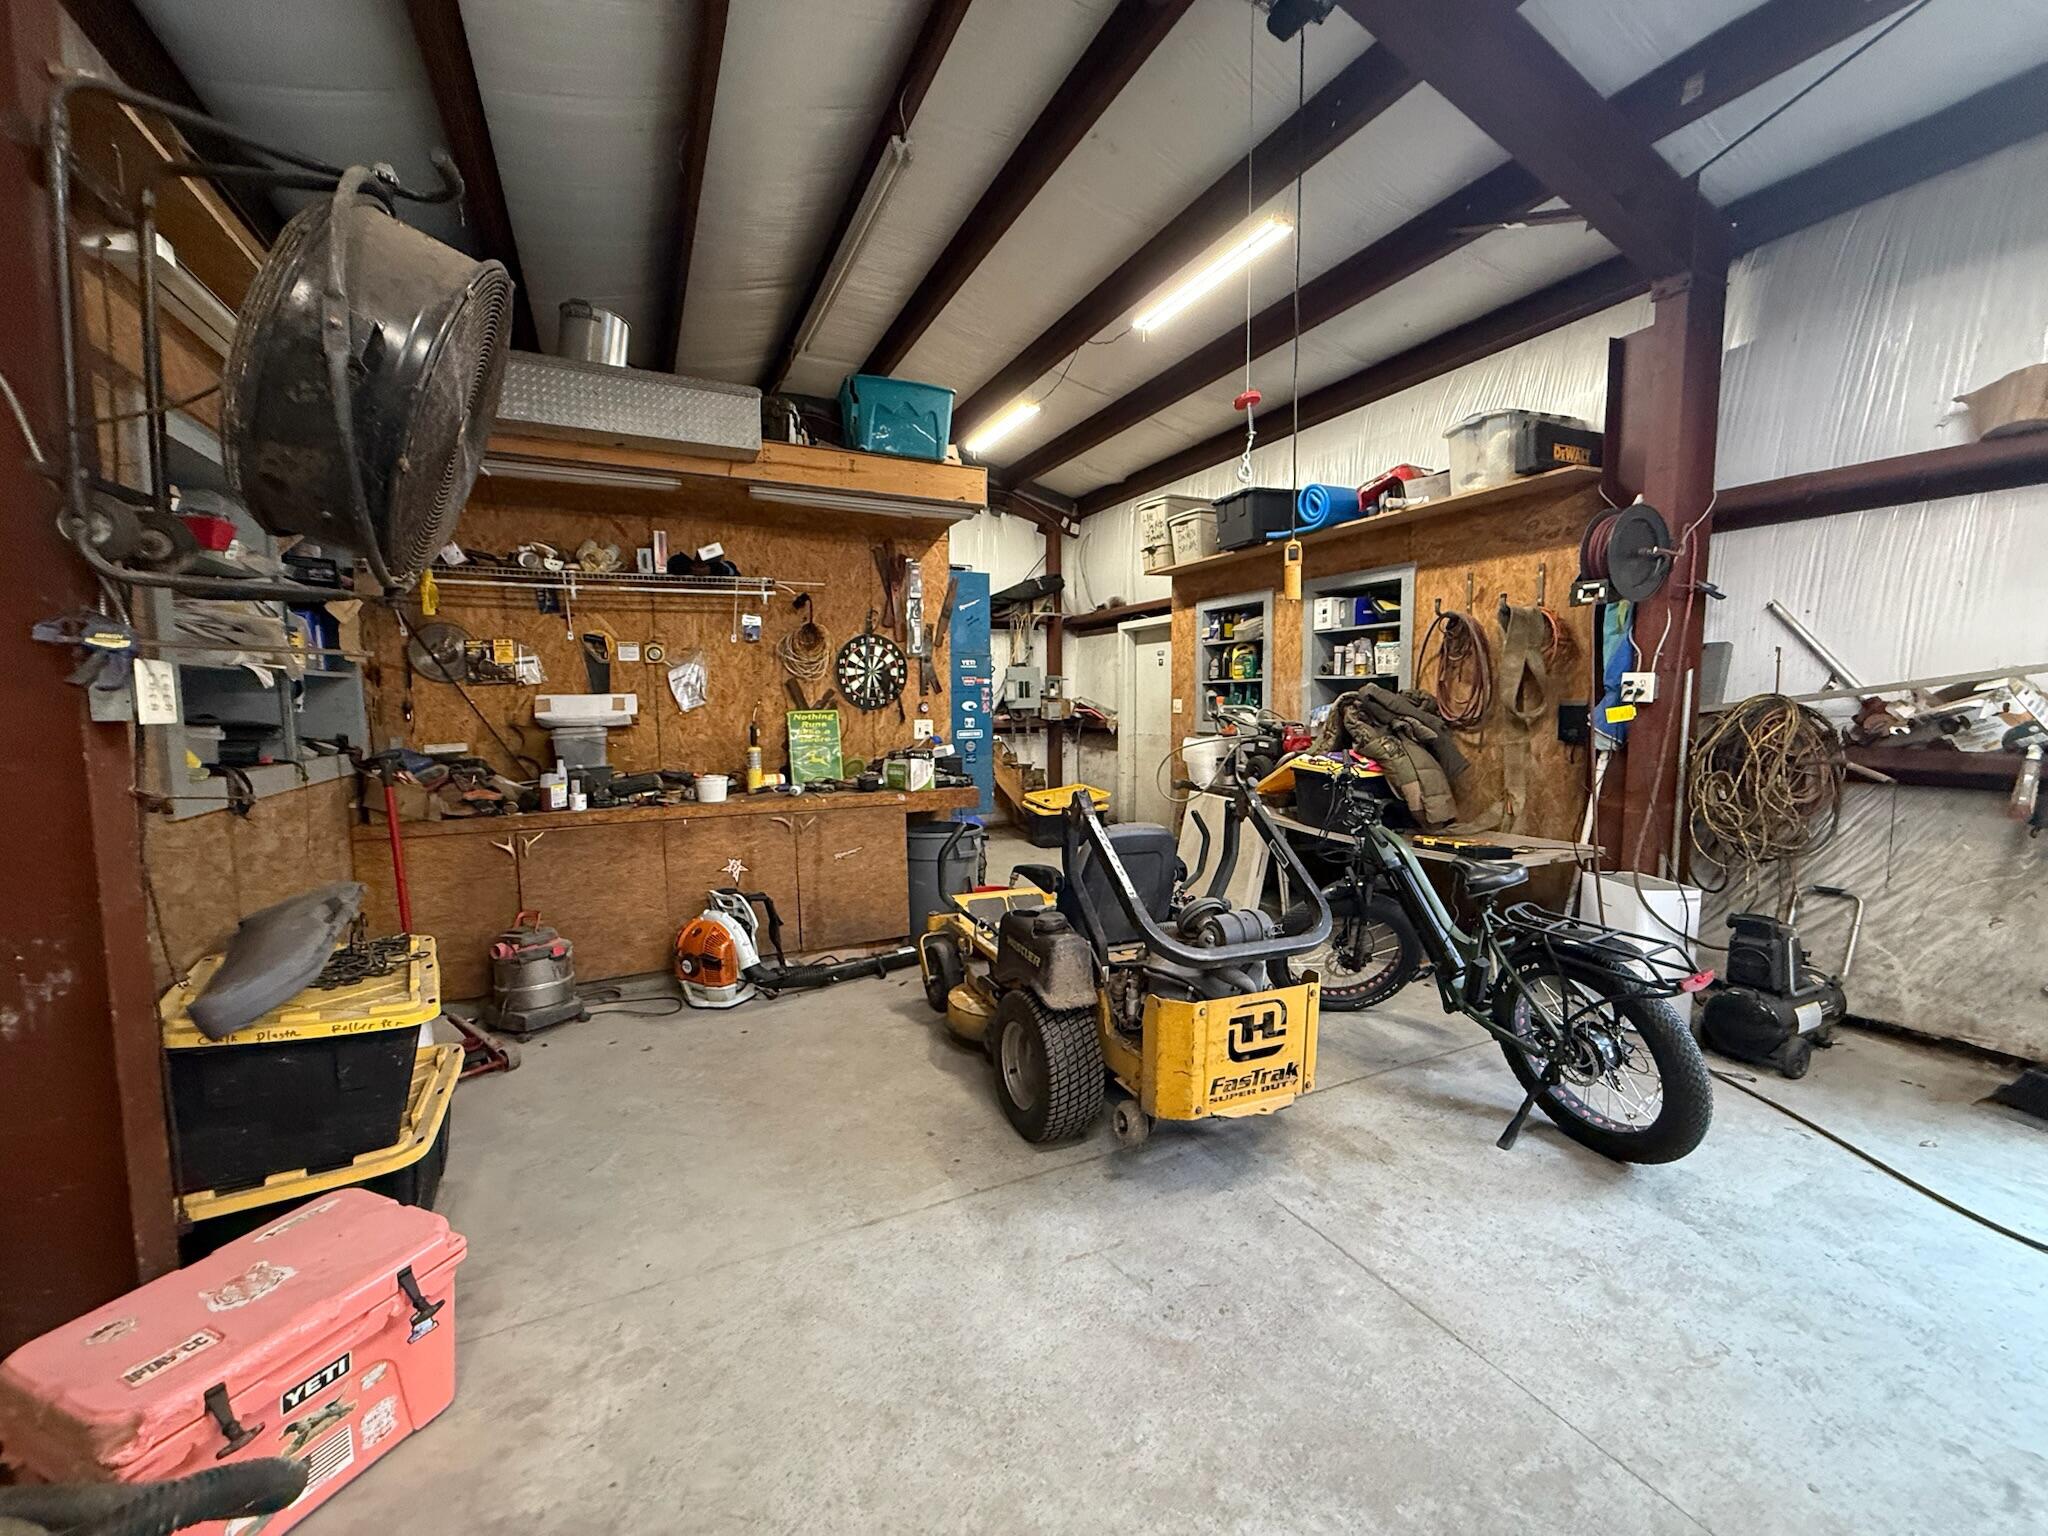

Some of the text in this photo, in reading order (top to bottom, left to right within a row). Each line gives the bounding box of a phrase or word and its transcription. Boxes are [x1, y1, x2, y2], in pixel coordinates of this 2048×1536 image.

[793, 713, 834, 721] Nothing
[1501, 962, 1540, 993] KEDA
[1260, 1078, 1299, 1093] DUTY
[284, 1358, 348, 1406] YETI
